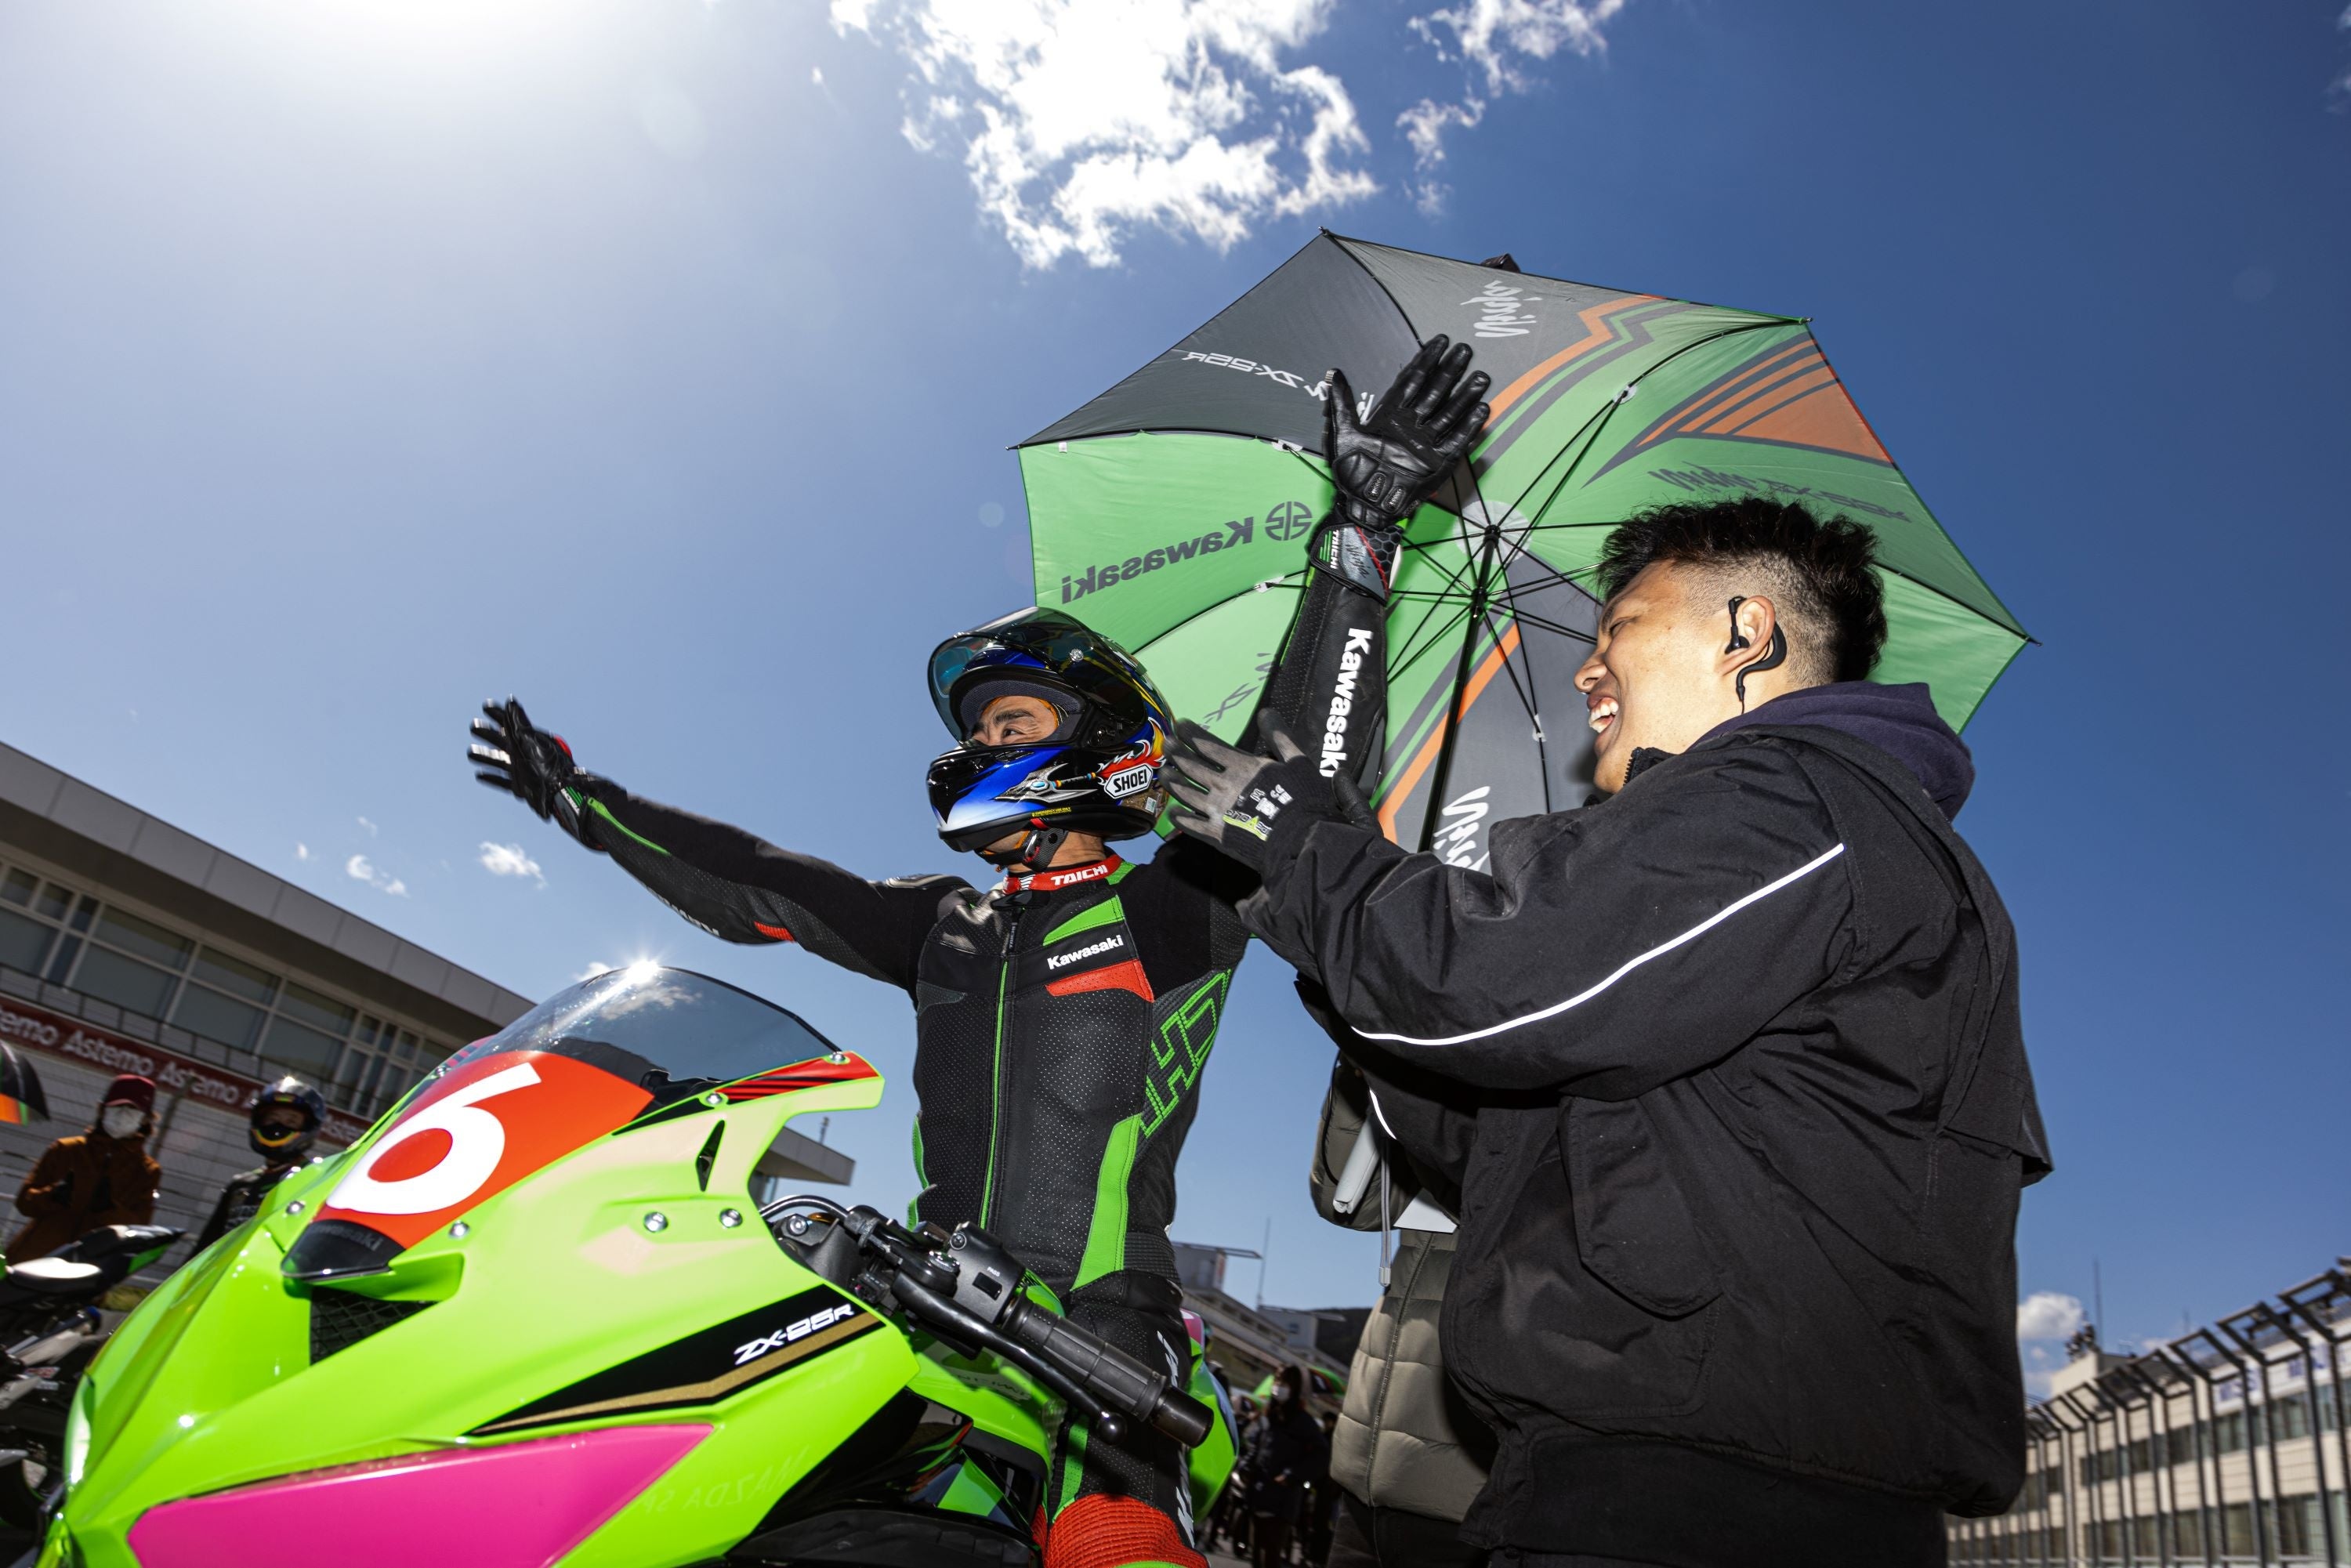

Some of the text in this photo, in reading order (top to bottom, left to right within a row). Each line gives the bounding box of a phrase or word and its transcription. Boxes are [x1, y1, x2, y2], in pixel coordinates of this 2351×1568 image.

[1330, 529, 1339, 570] TAICHI
[1113, 769, 1147, 794] SHOEI
[1050, 864, 1108, 886] TAICHI
[1047, 935, 1124, 970] Kawasaki
[0, 1010, 59, 1047] emo
[63, 1029, 154, 1077] Astemo
[326, 1062, 542, 1215] 6
[312, 1223, 384, 1252] wasaki
[987, 1266, 1001, 1277] PASS
[734, 1303, 855, 1366] ZX-25R
